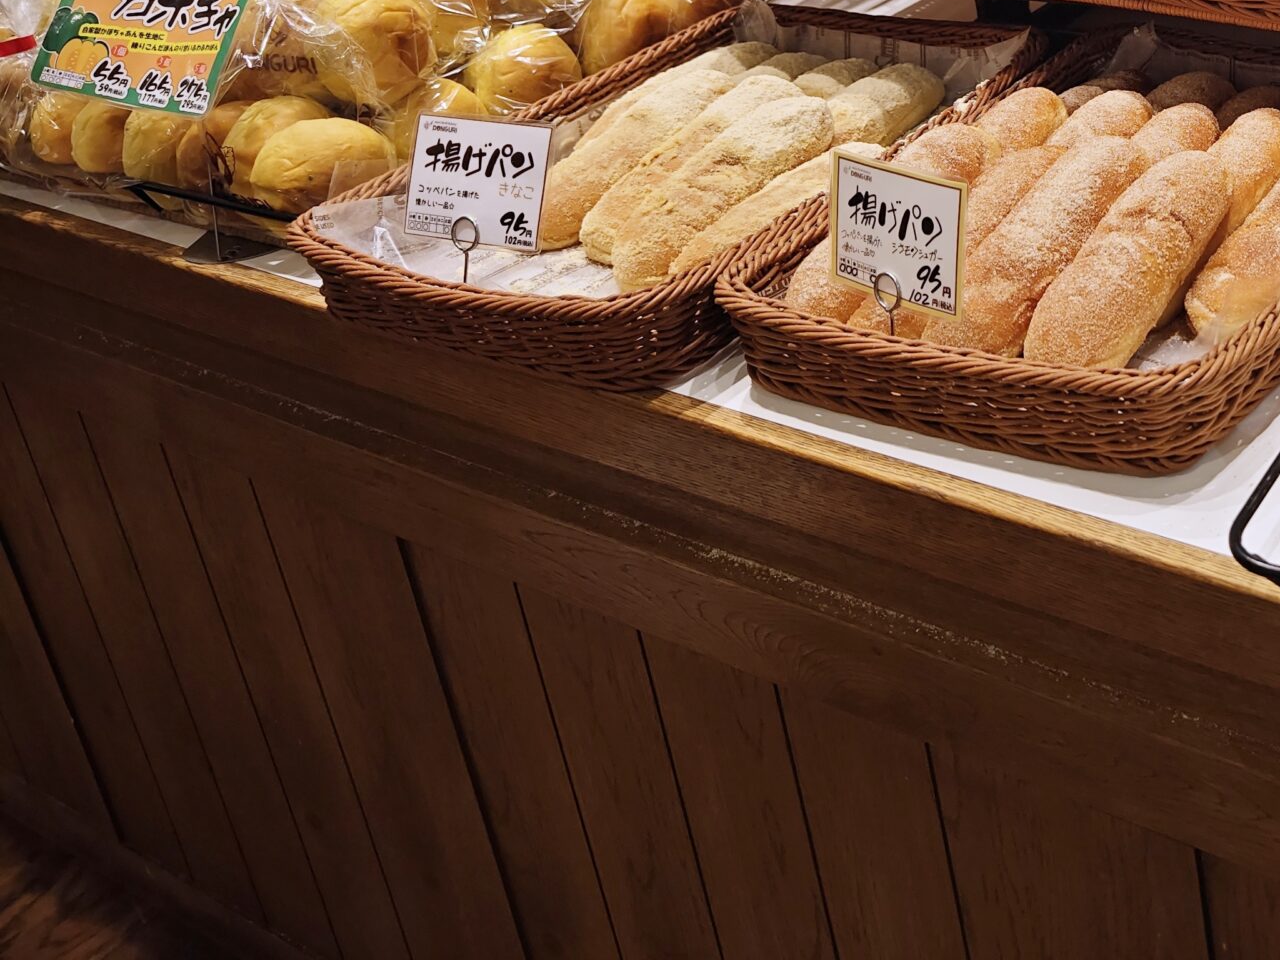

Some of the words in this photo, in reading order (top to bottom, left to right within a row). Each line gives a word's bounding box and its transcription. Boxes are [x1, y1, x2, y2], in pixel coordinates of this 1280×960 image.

[93, 60, 129, 87] 55円
[425, 139, 534, 178] 揚げパン
[499, 182, 534, 200] きなこ
[500, 211, 532, 238] 95円
[848, 185, 942, 247] 揚げパン
[917, 265, 951, 298] 95円
